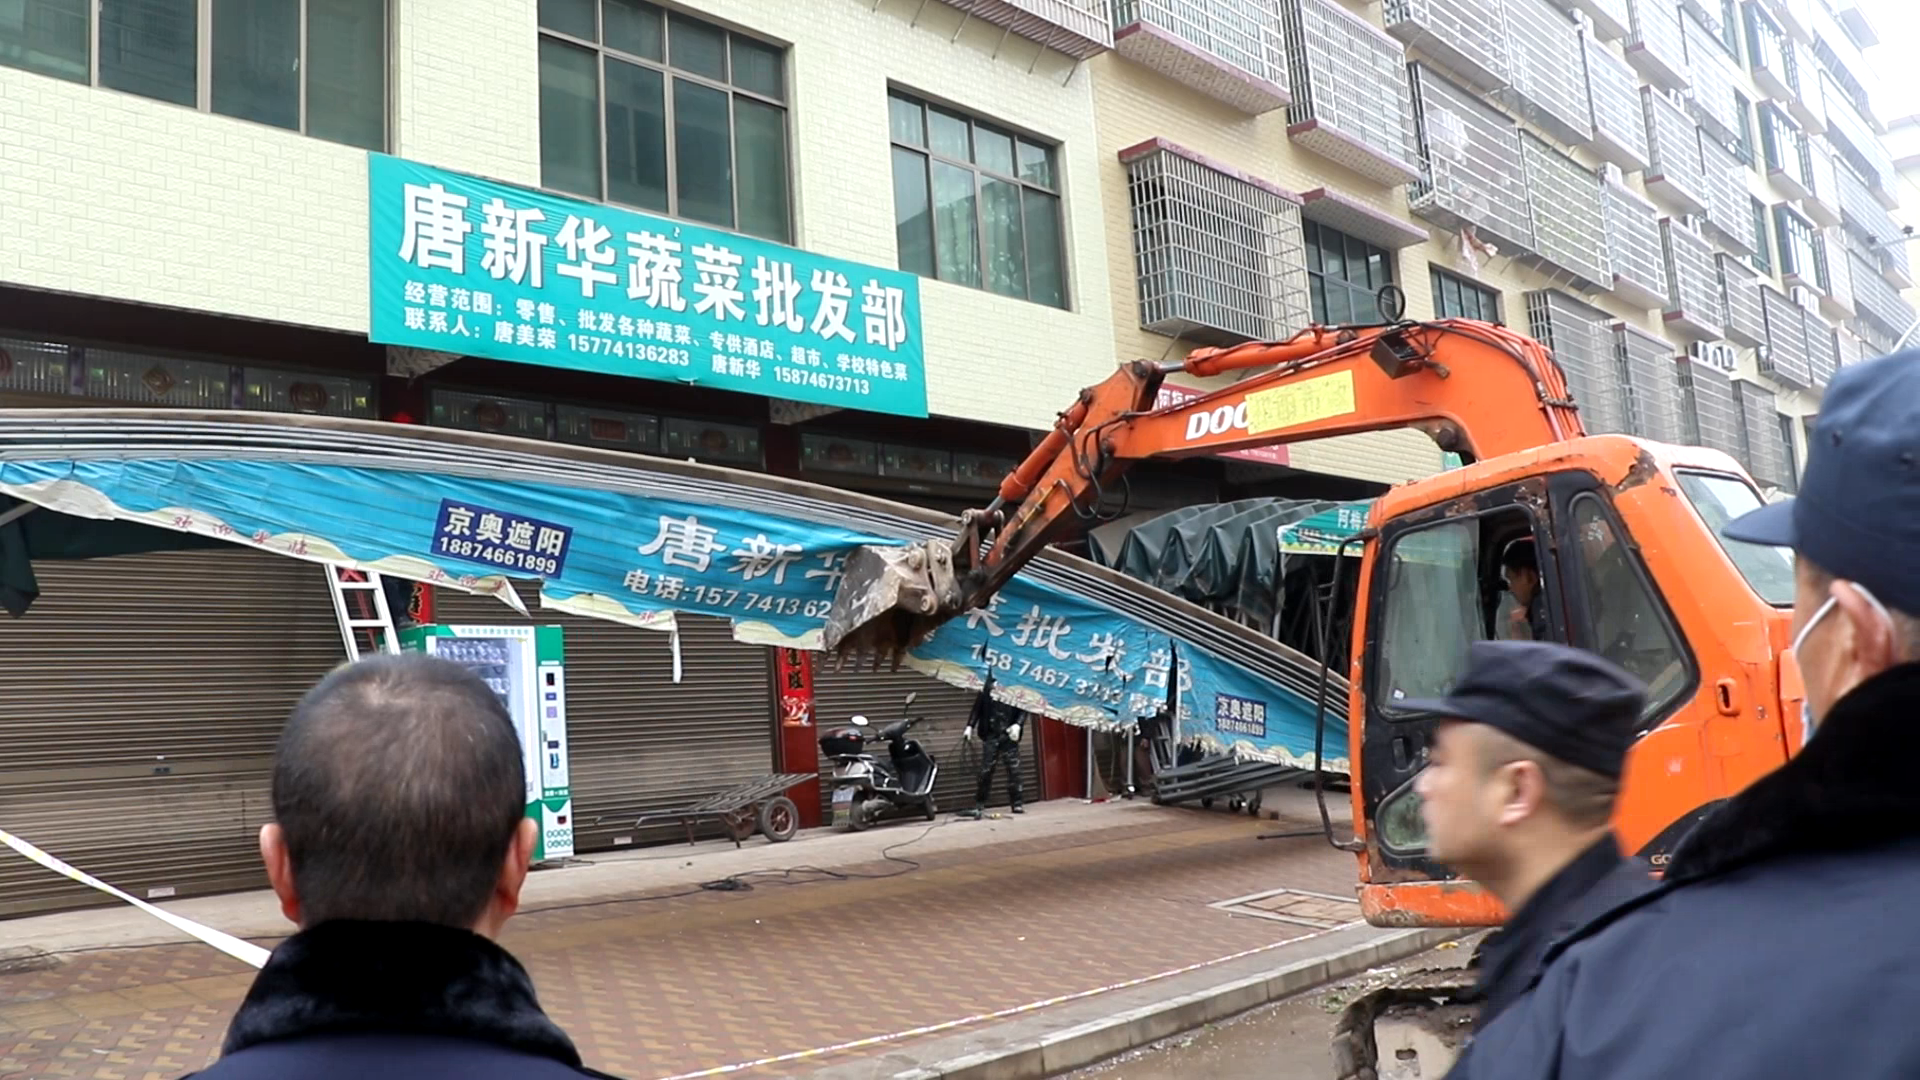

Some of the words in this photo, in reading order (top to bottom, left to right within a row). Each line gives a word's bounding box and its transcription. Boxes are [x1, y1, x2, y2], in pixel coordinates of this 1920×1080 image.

[398, 182, 907, 352] 唐新华蔬菜批发部
[568, 333, 690, 367] 15774136283
[711, 353, 761, 380] 唐新华
[773, 365, 871, 395] 15874673713
[440, 536, 557, 575] 18874661899
[443, 506, 565, 557] 京奥遮阳
[1217, 696, 1265, 724] 京奥遮阳
